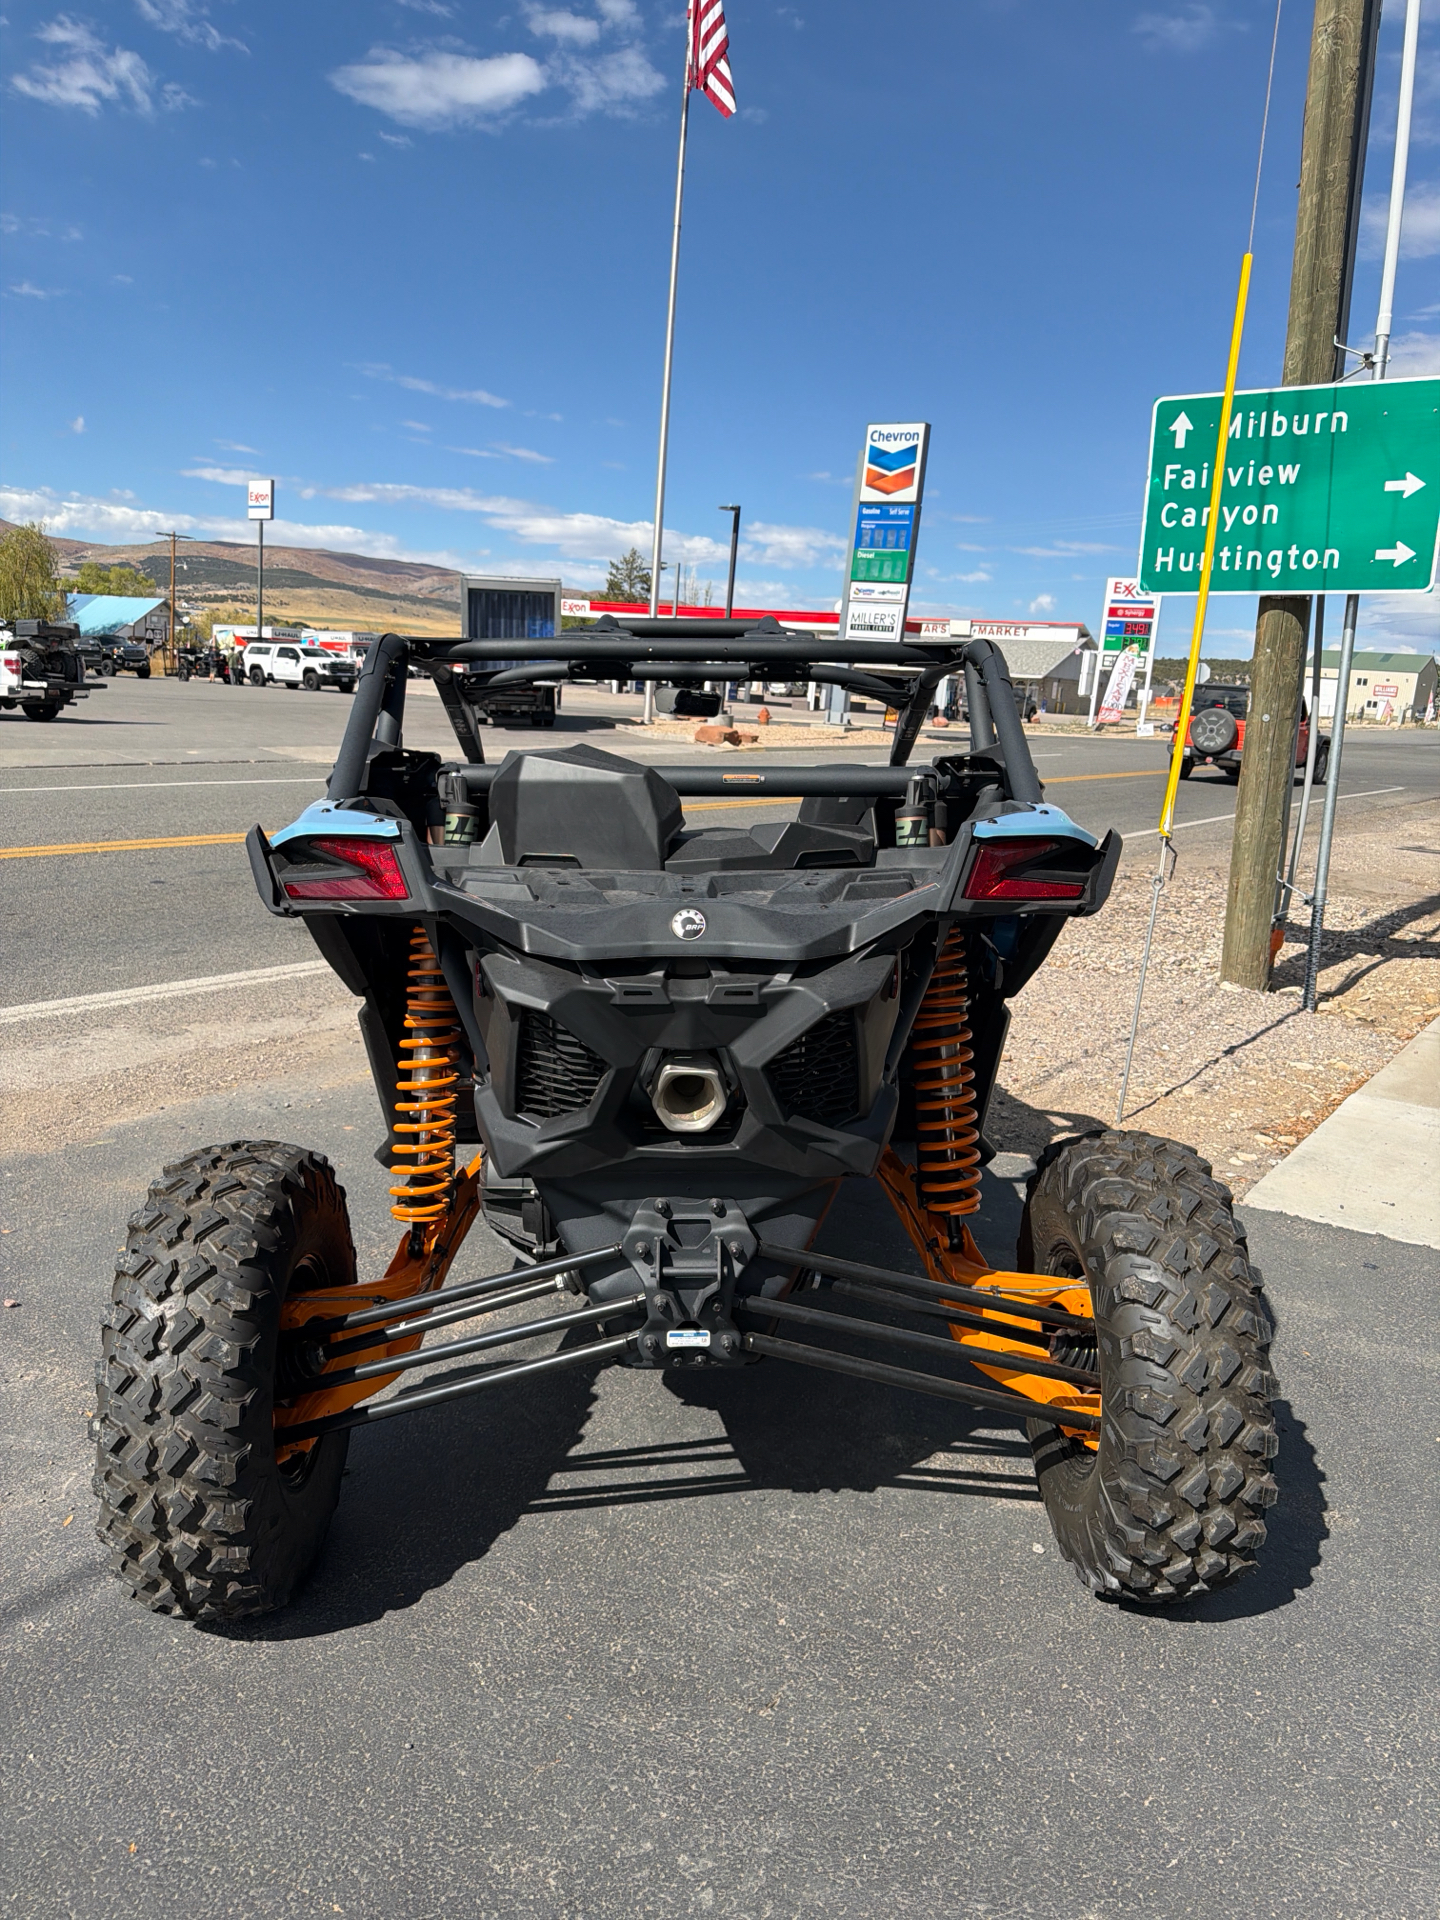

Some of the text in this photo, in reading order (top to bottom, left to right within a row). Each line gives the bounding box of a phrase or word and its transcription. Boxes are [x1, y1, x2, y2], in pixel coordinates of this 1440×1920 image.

[1229, 410, 1348, 439] Milburn
[870, 430, 919, 442] Chevron
[1164, 460, 1300, 490] Faiview
[250, 491, 270, 504] Exxon
[562, 601, 587, 615] Exxon
[850, 612, 897, 625] MILLER'S
[978, 626, 1029, 636] MARKET
[1111, 655, 1135, 702] MEXICAN
